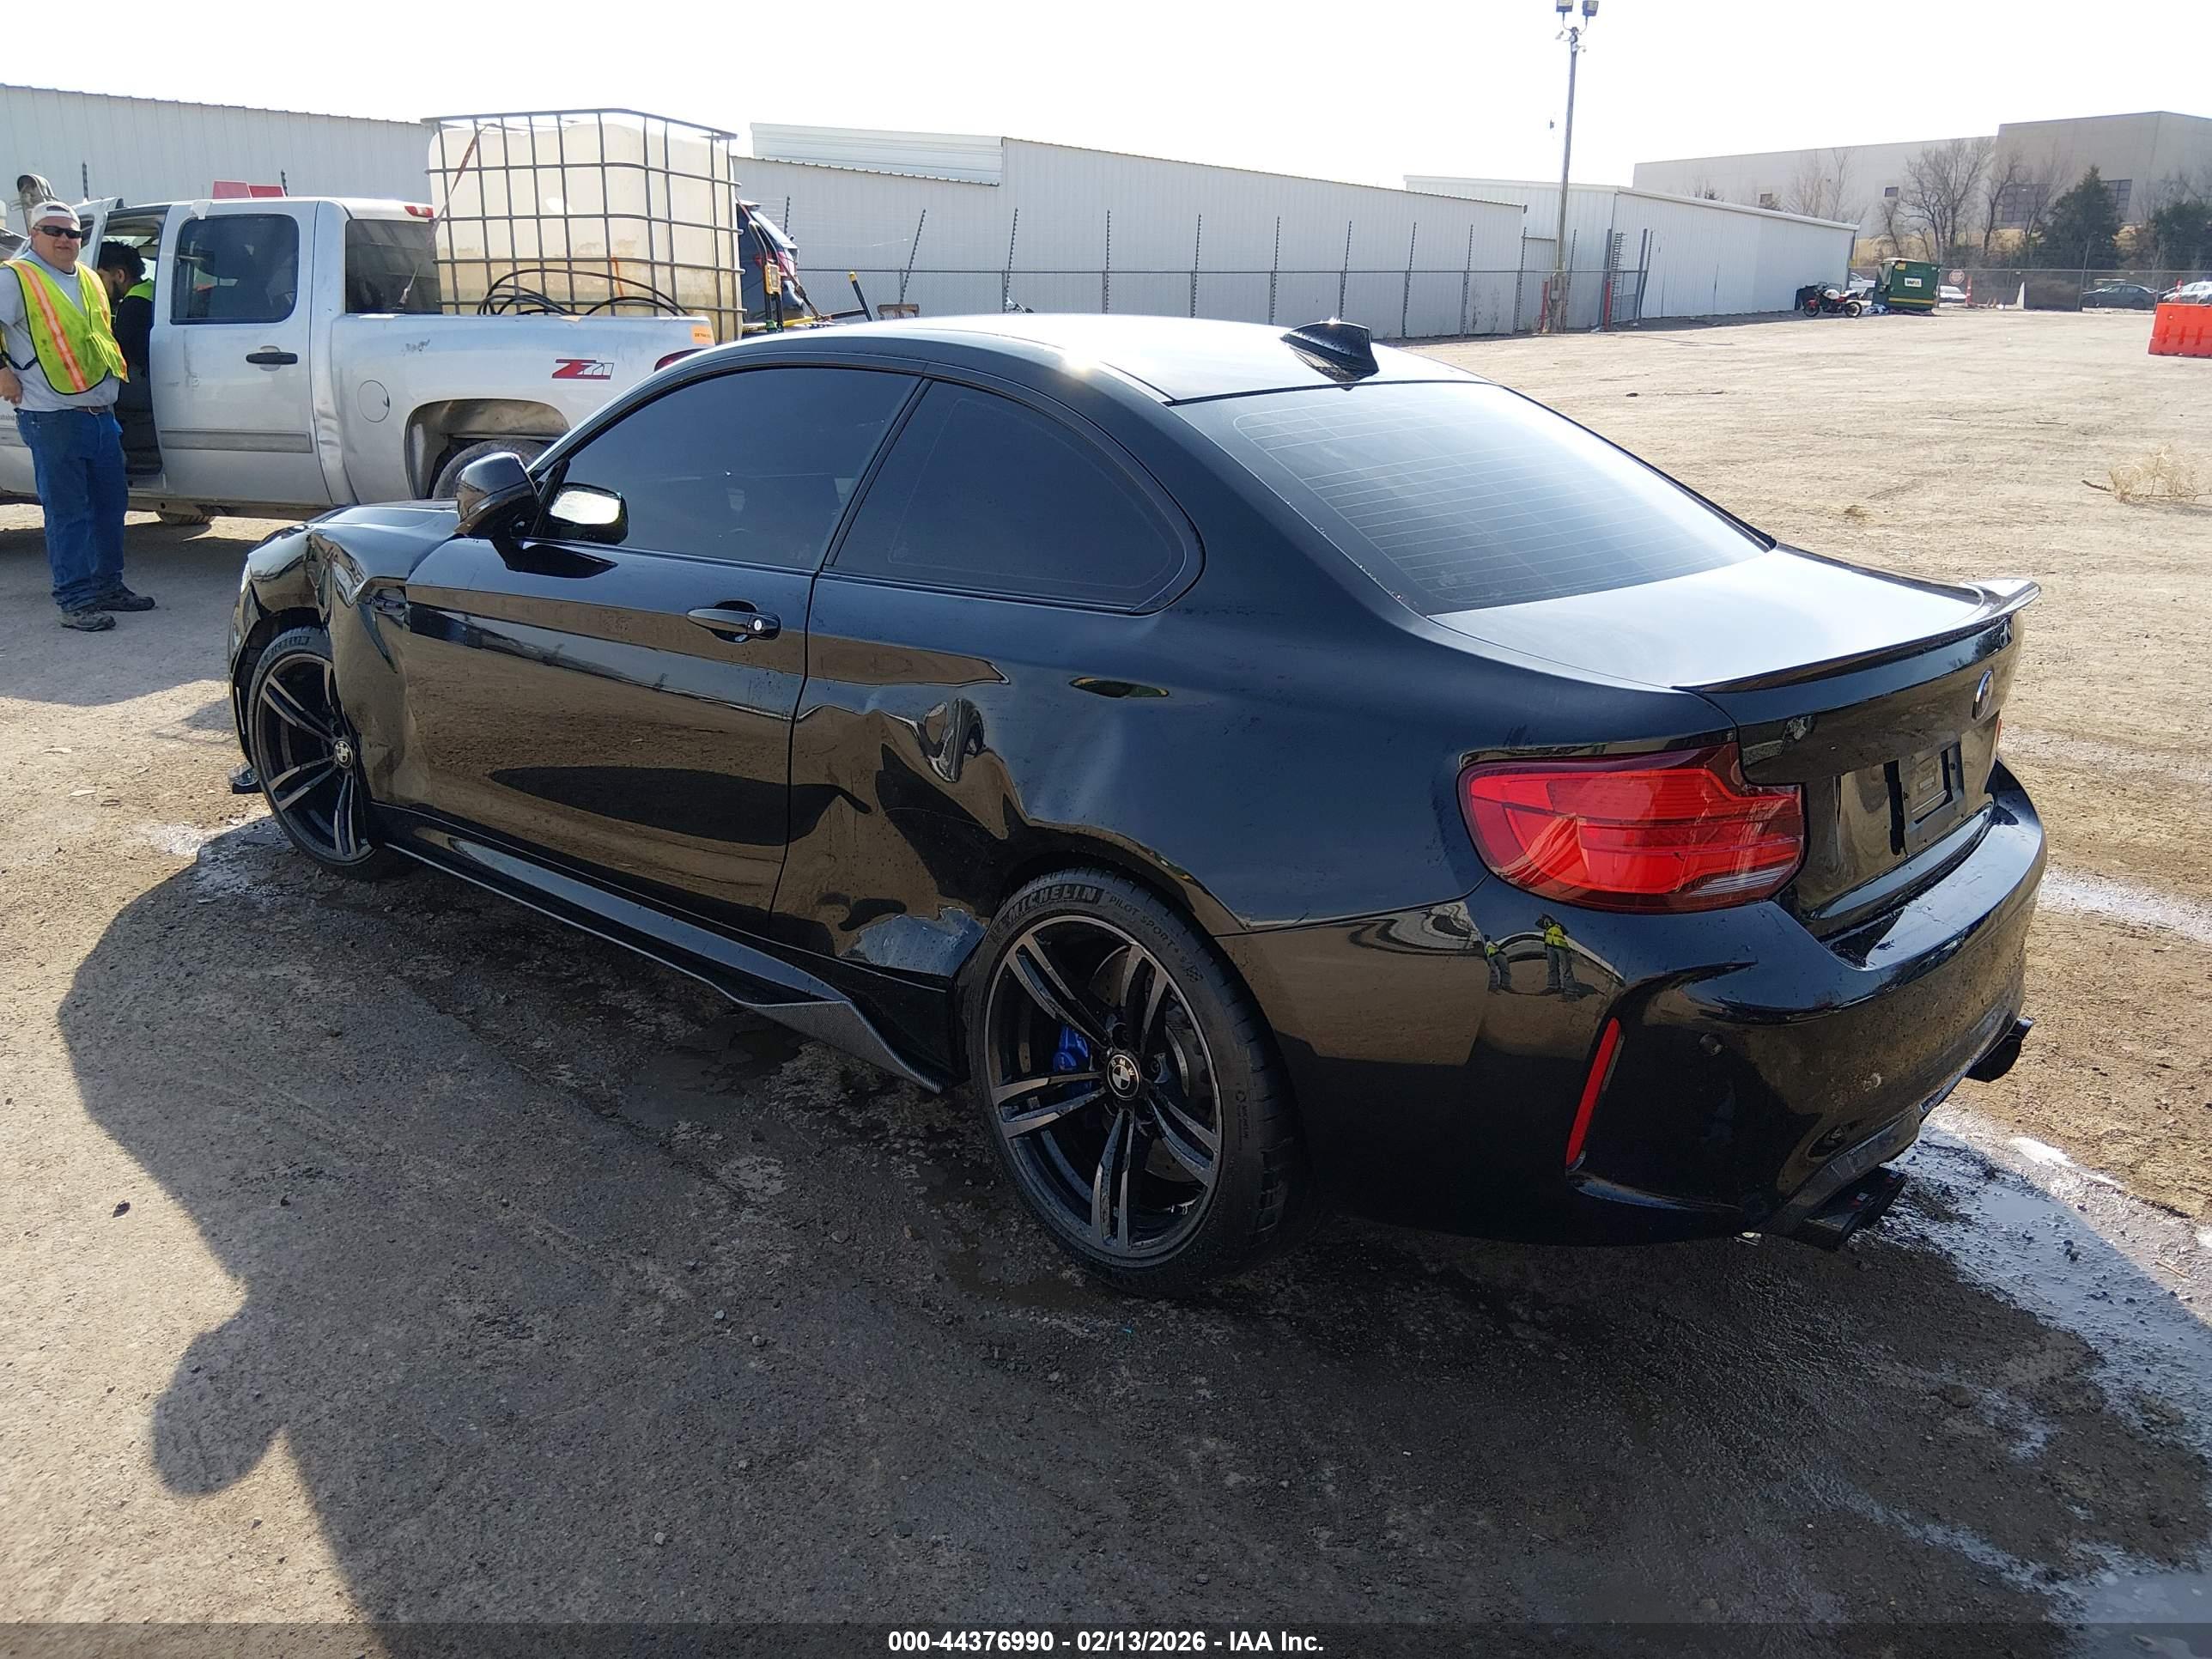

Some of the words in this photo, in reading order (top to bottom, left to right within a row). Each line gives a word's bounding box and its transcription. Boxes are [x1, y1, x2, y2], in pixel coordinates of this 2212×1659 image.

[551, 358, 615, 380] Z71
[1007, 884, 1098, 923] MICHELIN
[1109, 895, 1140, 916] PILOT
[1140, 915, 1176, 947] SPORT
[1111, 1057, 1135, 1076] BMW
